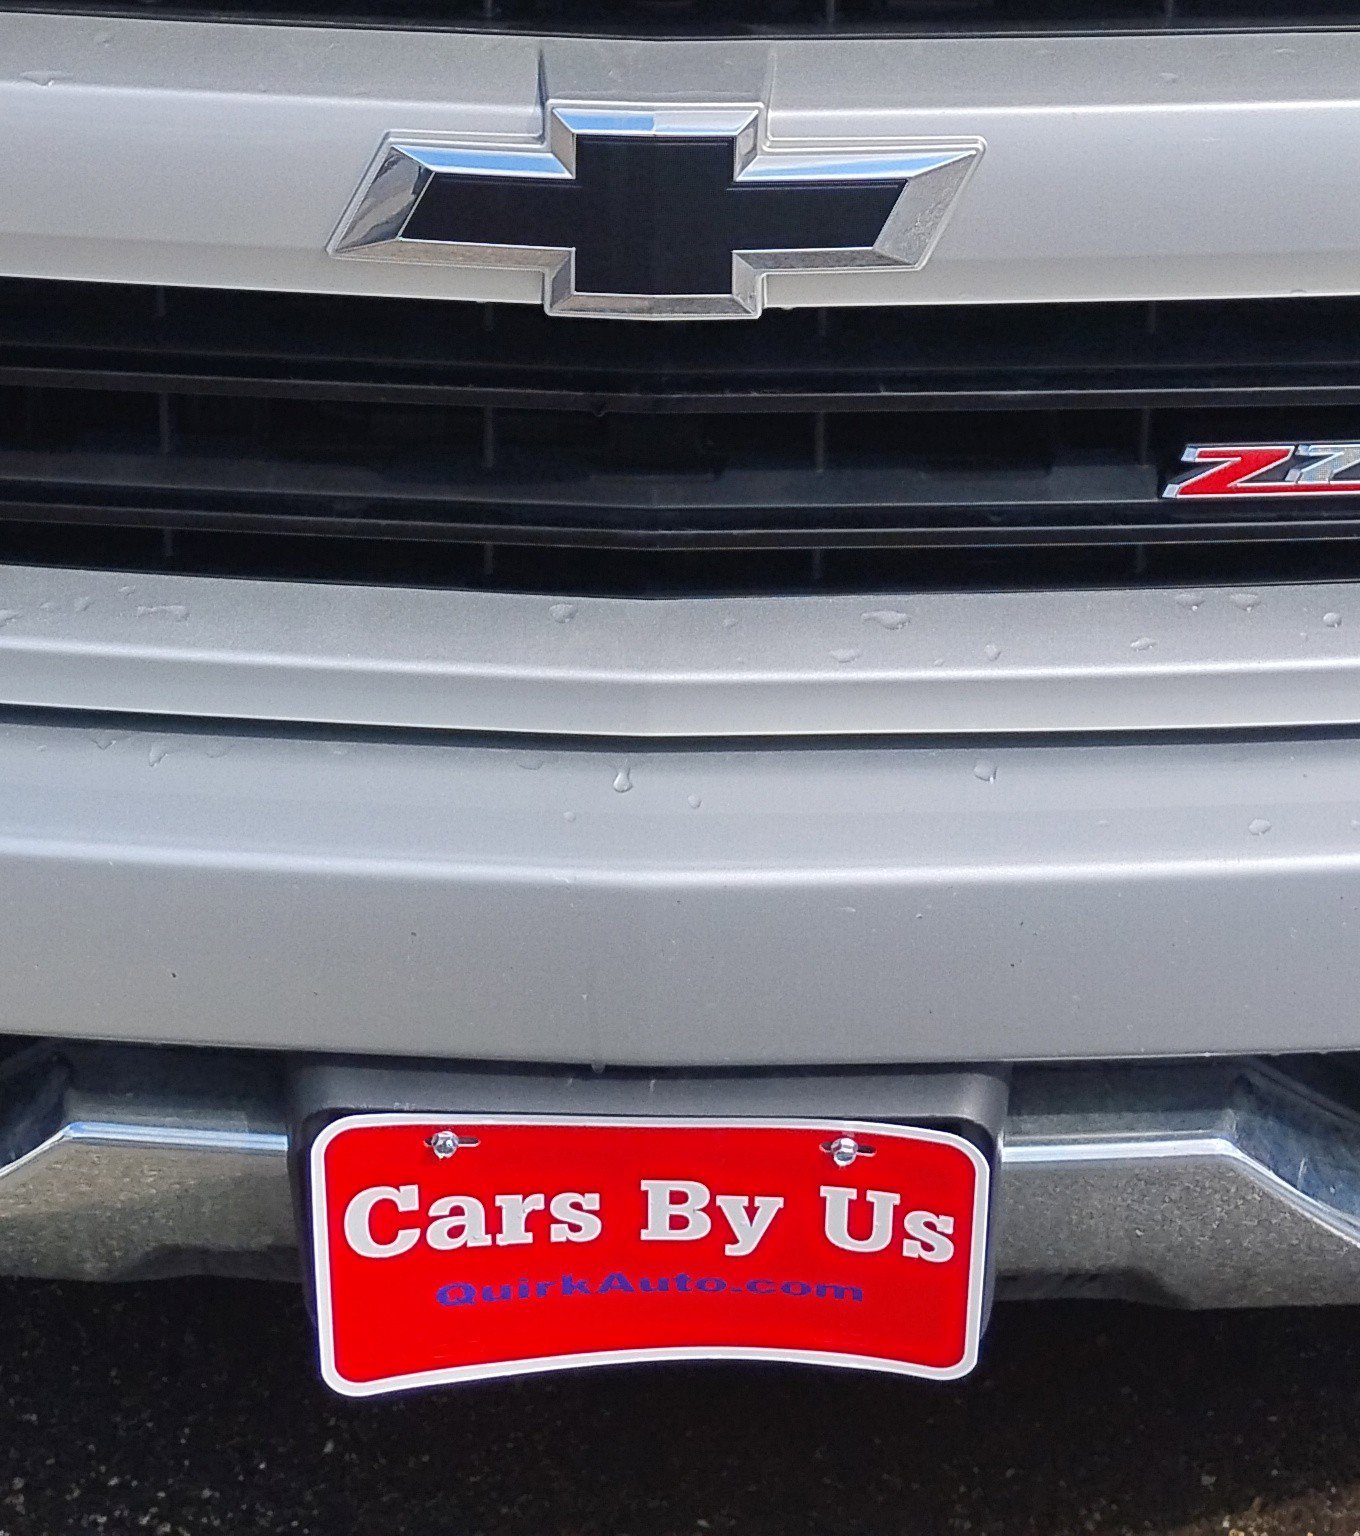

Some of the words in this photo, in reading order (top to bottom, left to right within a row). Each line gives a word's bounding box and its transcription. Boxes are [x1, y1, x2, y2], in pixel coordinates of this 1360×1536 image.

[343, 1184, 603, 1259] Cars
[640, 1179, 784, 1257] By
[819, 1185, 955, 1263] Us
[435, 1272, 864, 1307] QuirkAuto.com
